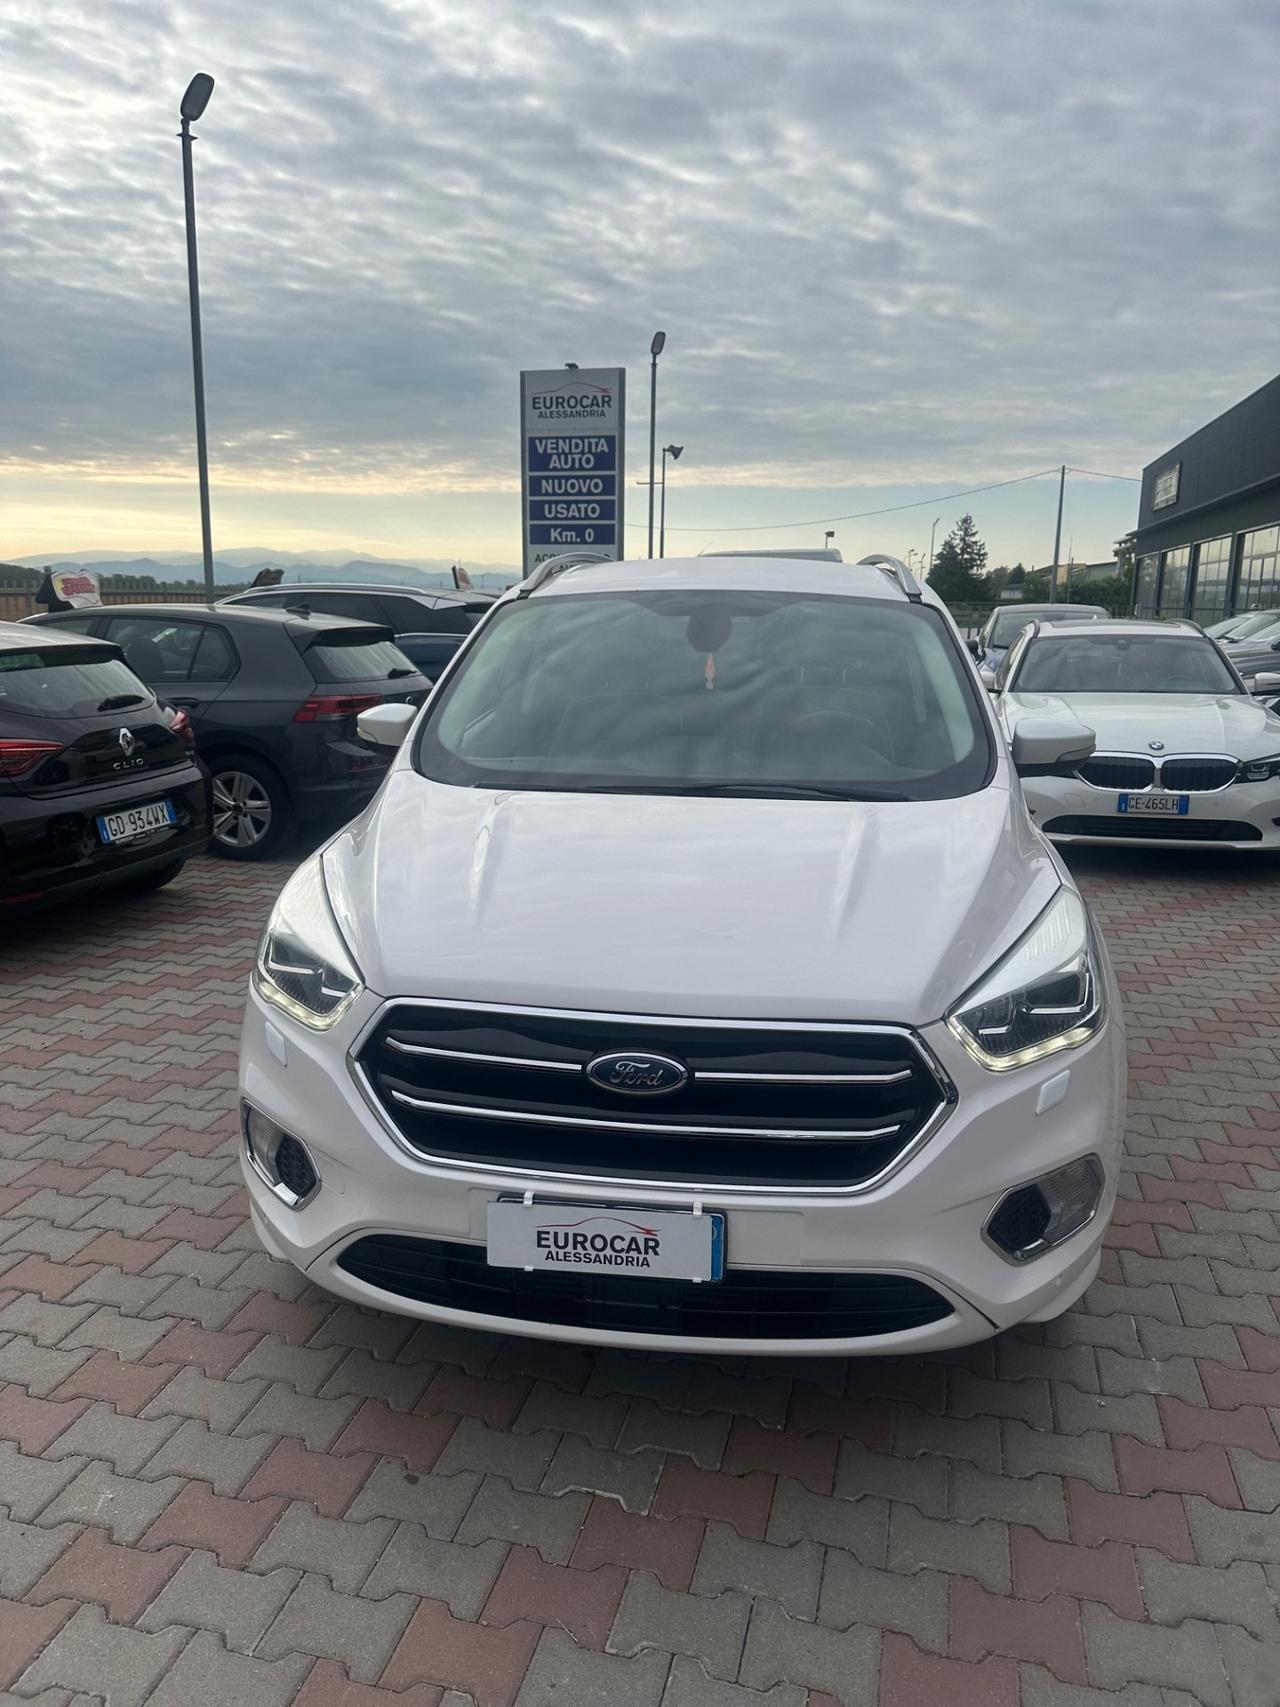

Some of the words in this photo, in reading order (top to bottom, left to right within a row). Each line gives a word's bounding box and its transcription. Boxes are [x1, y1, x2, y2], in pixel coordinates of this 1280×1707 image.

[532, 395, 612, 410] EUROCAR
[538, 409, 606, 419] ALESSANDRIA
[535, 438, 609, 453] VENDITA
[549, 454, 594, 469] AUTO
[541, 478, 603, 494] NUOVO
[544, 503, 600, 518] USATO
[550, 528, 581, 543] Km.
[585, 528, 594, 543] 0
[113, 758, 144, 770] CLIO
[610, 1060, 663, 1086] Ford
[536, 1230, 660, 1257] EUROCAR
[544, 1250, 651, 1268] ALESSANDRIA
